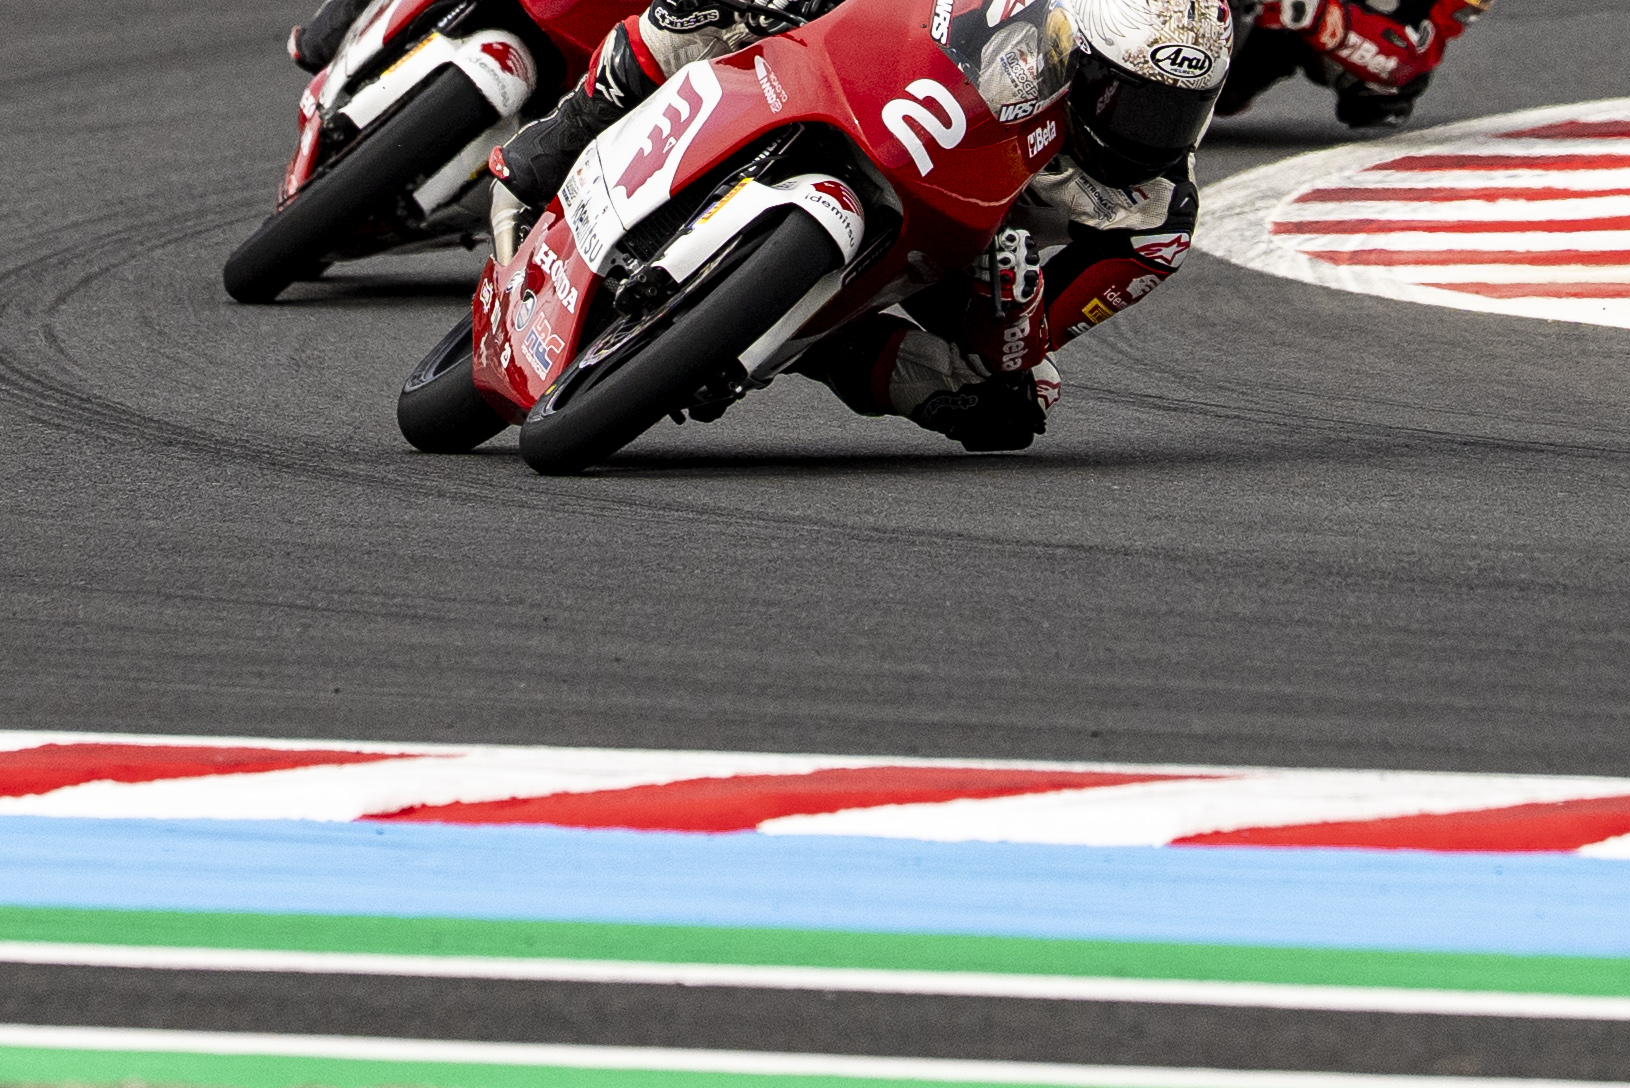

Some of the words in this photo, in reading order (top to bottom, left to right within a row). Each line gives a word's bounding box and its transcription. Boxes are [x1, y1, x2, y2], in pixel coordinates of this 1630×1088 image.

[1005, 51, 1039, 100] MotoGP
[1154, 48, 1206, 71] Arai
[881, 78, 966, 174] 2
[1000, 100, 1037, 123] WRS
[1034, 120, 1057, 154] Beta
[1079, 174, 1113, 211] PETRONAS
[804, 192, 856, 248] idemitsu
[534, 242, 579, 315] HONDA
[1002, 322, 1031, 372] Beta
